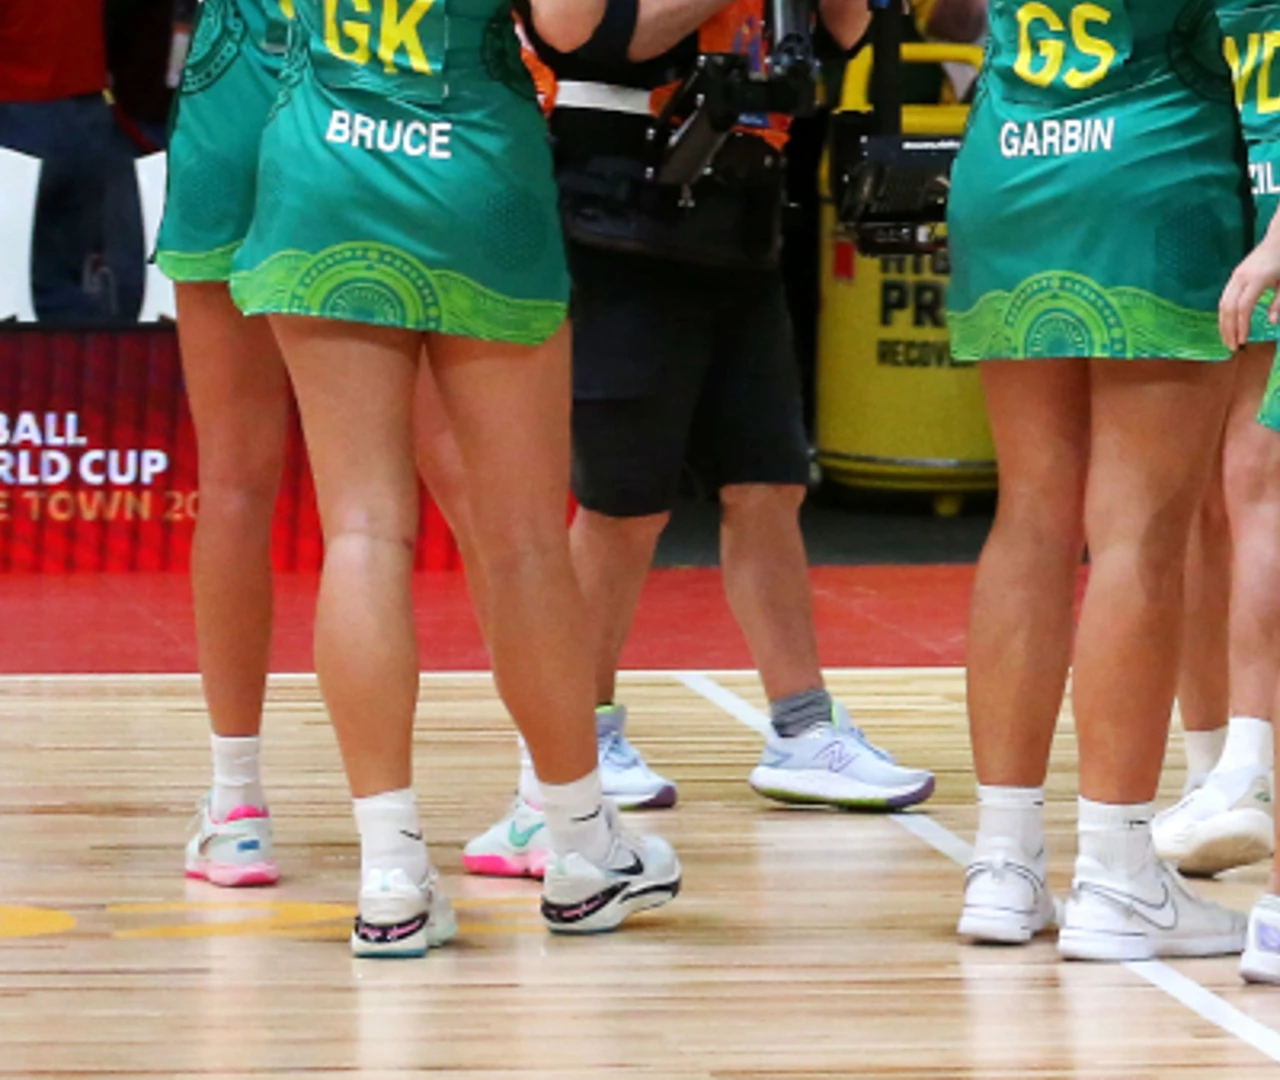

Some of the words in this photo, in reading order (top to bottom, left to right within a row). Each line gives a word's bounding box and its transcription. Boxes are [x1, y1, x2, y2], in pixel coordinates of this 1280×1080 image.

[1013, 1, 1117, 89] GS
[326, 110, 451, 159] BRUCE
[1000, 117, 1115, 158] GARBIN
[79, 449, 168, 485] CUP
[22, 491, 151, 520] TOWN
